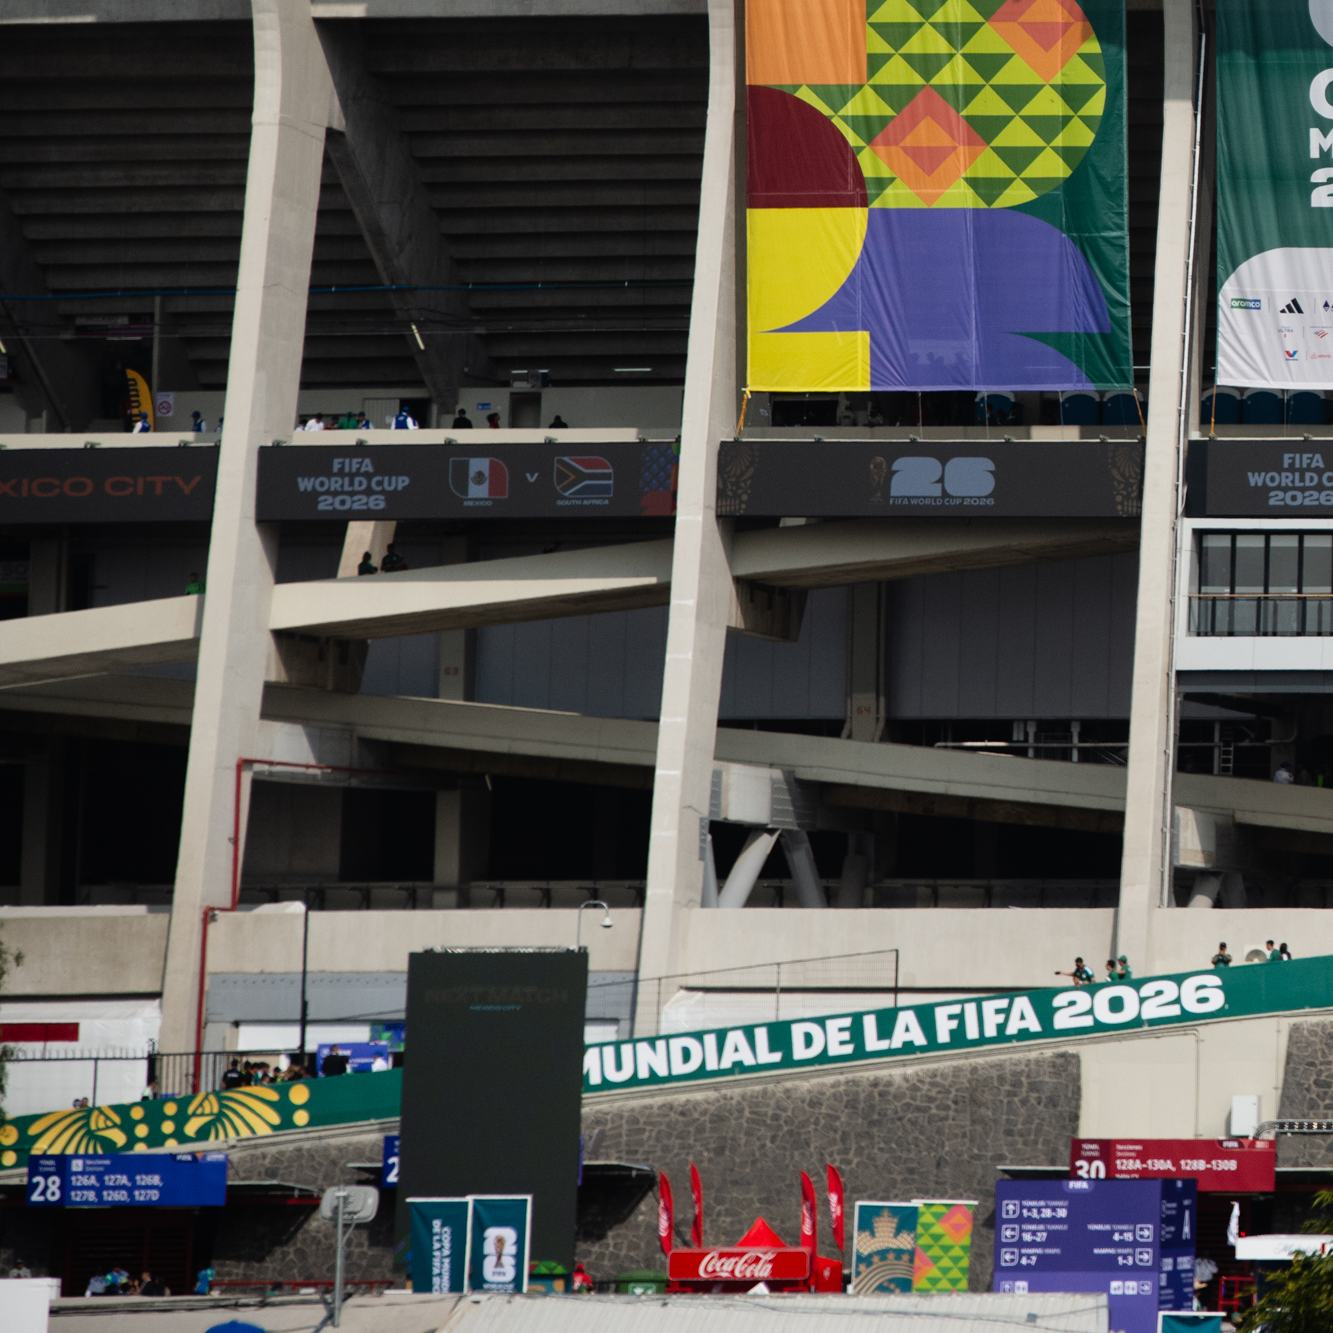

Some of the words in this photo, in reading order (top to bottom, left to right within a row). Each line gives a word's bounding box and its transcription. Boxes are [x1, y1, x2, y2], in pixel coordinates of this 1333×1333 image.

[1231, 300, 1261, 308] aramco
[332, 458, 374, 473] FIFA
[1283, 453, 1325, 468] FIFA
[297, 476, 368, 492] WORLD
[372, 476, 410, 491] CUP
[890, 456, 996, 497] 26
[1247, 471, 1318, 487] WORLD
[104, 476, 201, 496] CITY
[317, 495, 386, 510] 2026
[791, 1017, 855, 1060] DE
[862, 1010, 928, 1052] LA
[934, 996, 1043, 1043] FIFA
[1052, 974, 1226, 1030] 2026
[70, 1174, 100, 1187] 126A,
[103, 1174, 132, 1187] 127A,
[1068, 1180, 1089, 1189] FIFA
[30, 1175, 62, 1202] 28
